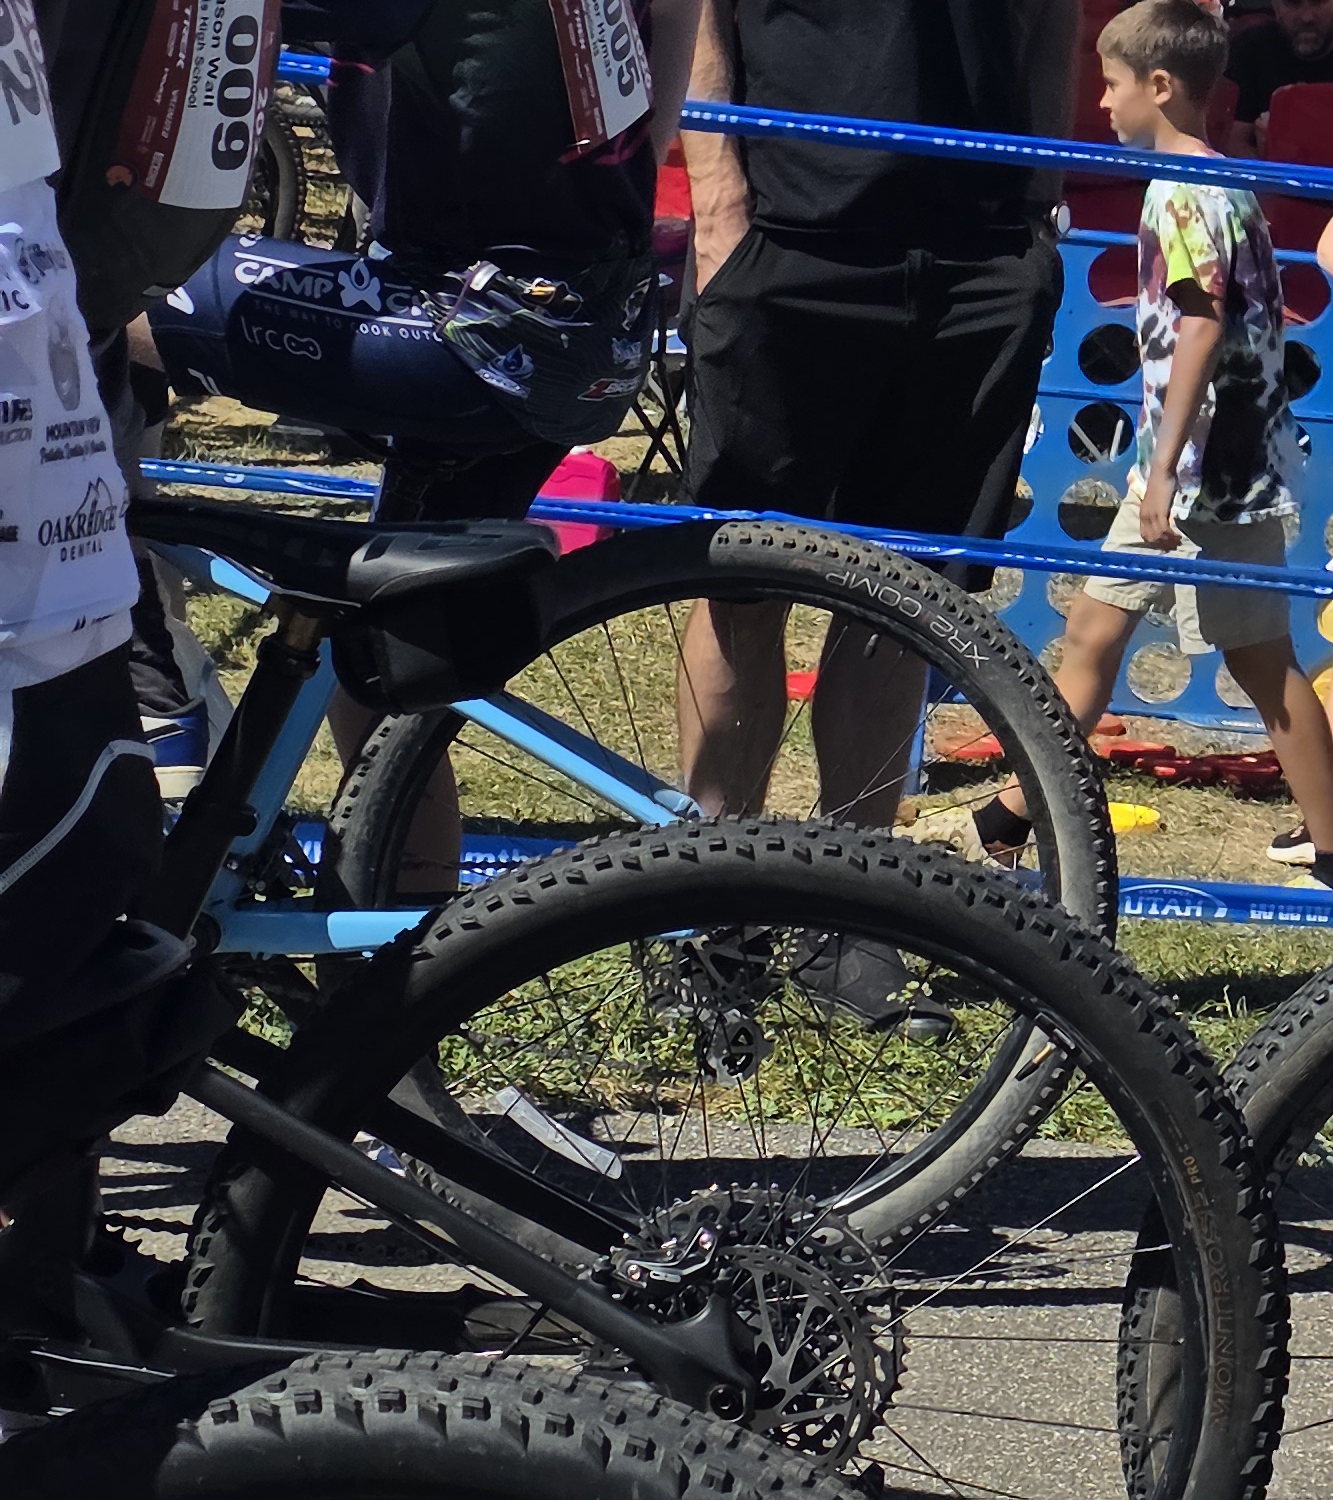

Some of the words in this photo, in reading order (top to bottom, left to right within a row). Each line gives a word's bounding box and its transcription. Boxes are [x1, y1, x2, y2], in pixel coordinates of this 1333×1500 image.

[195, 16, 209, 50] High
[597, 21, 613, 77] Hymas
[187, 56, 205, 109] School
[203, 57, 221, 107] Wall
[235, 261, 333, 300] CAMP
[38, 503, 118, 547] OAKRIDGE
[60, 544, 103, 562] DENTAL
[825, 570, 923, 618] COMP
[928, 613, 991, 669] XR2
[1183, 1158, 1203, 1184] PRO
